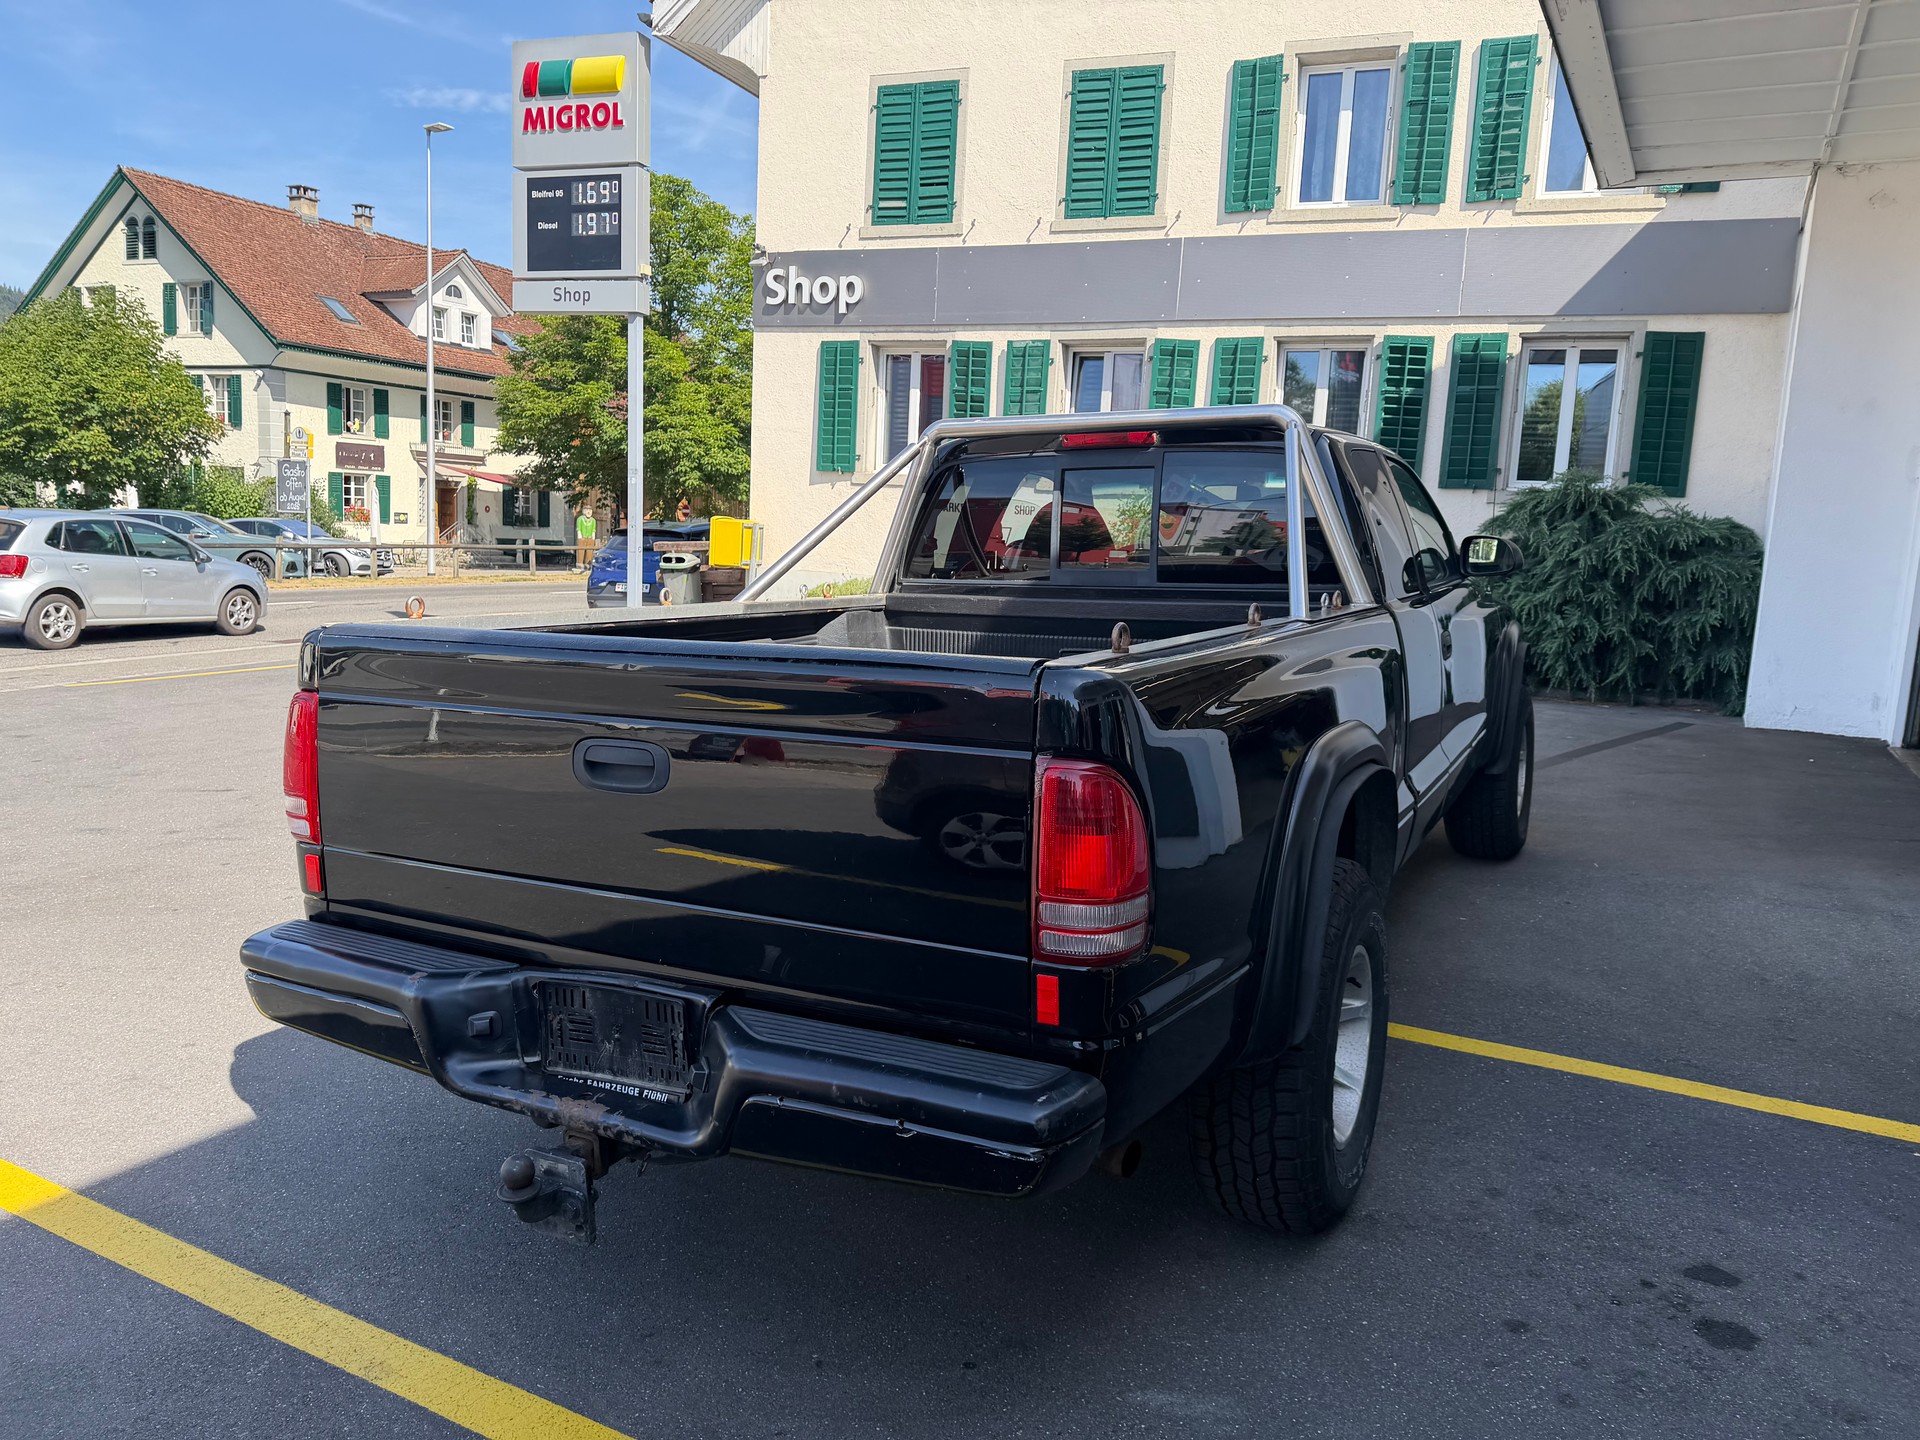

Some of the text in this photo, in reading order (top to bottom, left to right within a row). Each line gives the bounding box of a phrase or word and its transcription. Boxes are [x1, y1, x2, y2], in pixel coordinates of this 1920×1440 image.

[522, 101, 625, 132] MIGROL
[531, 189, 564, 198] Bleifrei 95
[537, 221, 558, 230] Diesel
[553, 286, 591, 306] Shop
[765, 265, 865, 314] Shop
[282, 463, 305, 477] Gastro
[285, 476, 302, 490] offen
[279, 491, 306, 503] ab August
[1014, 505, 1035, 516] SHOP
[587, 1079, 640, 1097] FAHRZEUGE
[642, 1089, 669, 1102] Flühli
